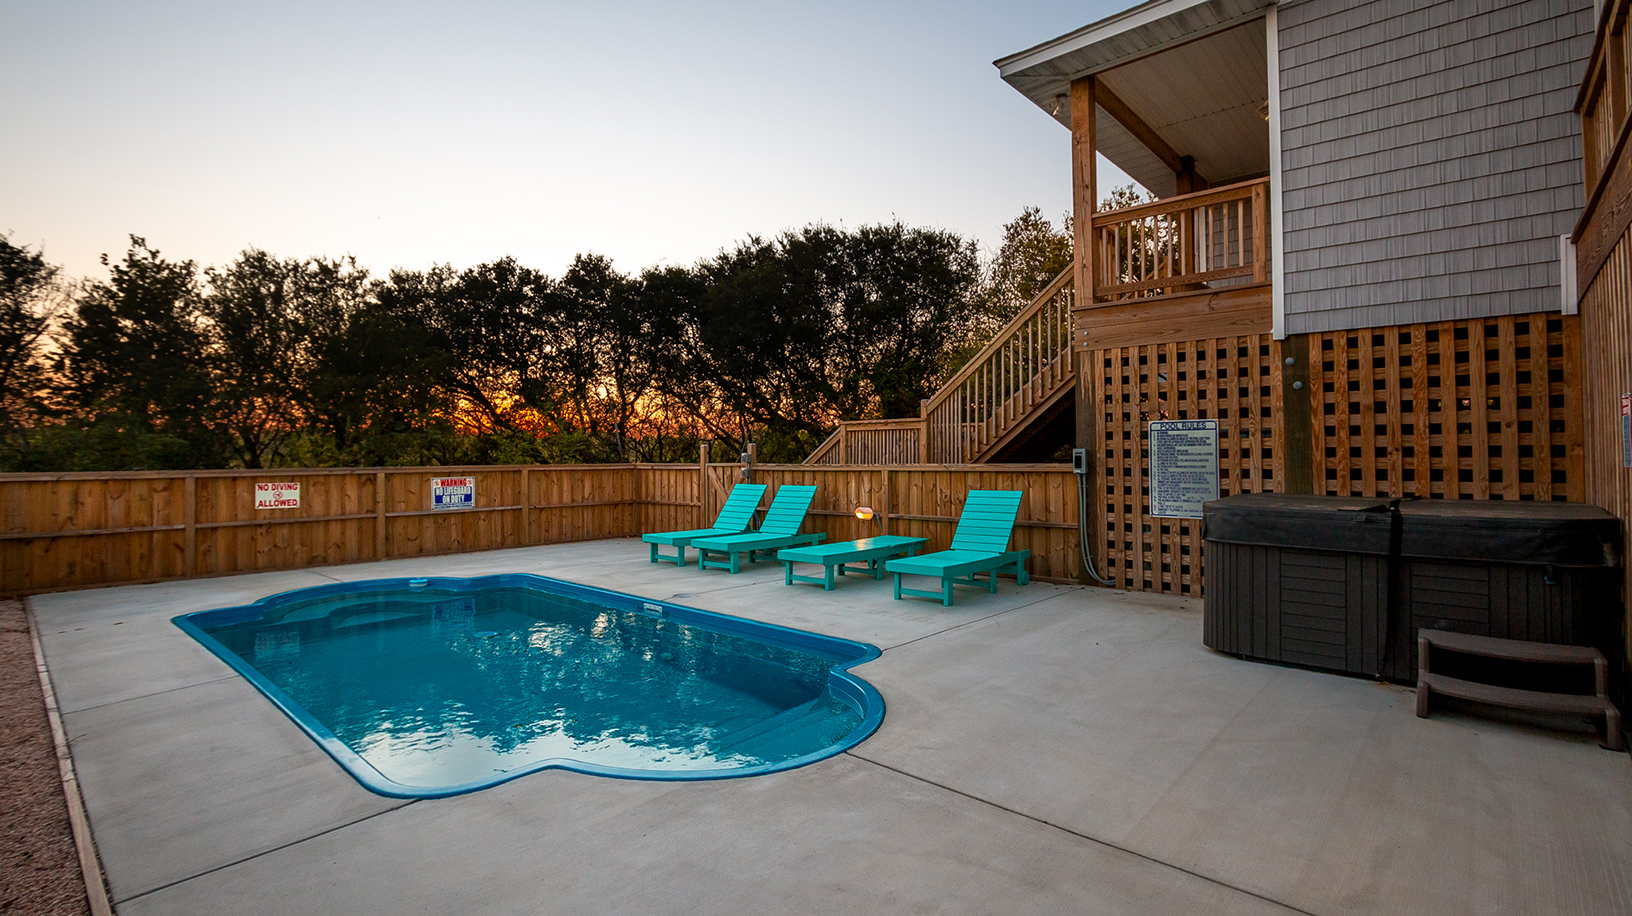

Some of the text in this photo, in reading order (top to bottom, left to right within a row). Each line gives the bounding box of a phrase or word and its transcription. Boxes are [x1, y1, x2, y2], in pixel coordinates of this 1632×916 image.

[1160, 422, 1207, 430] POOL RULES
[271, 483, 298, 491] DIVING
[440, 479, 467, 487] WARNING
[436, 486, 471, 496] NO LIFEGUARD
[443, 494, 466, 503] ON DUTY
[258, 499, 298, 507] ALLOWED
